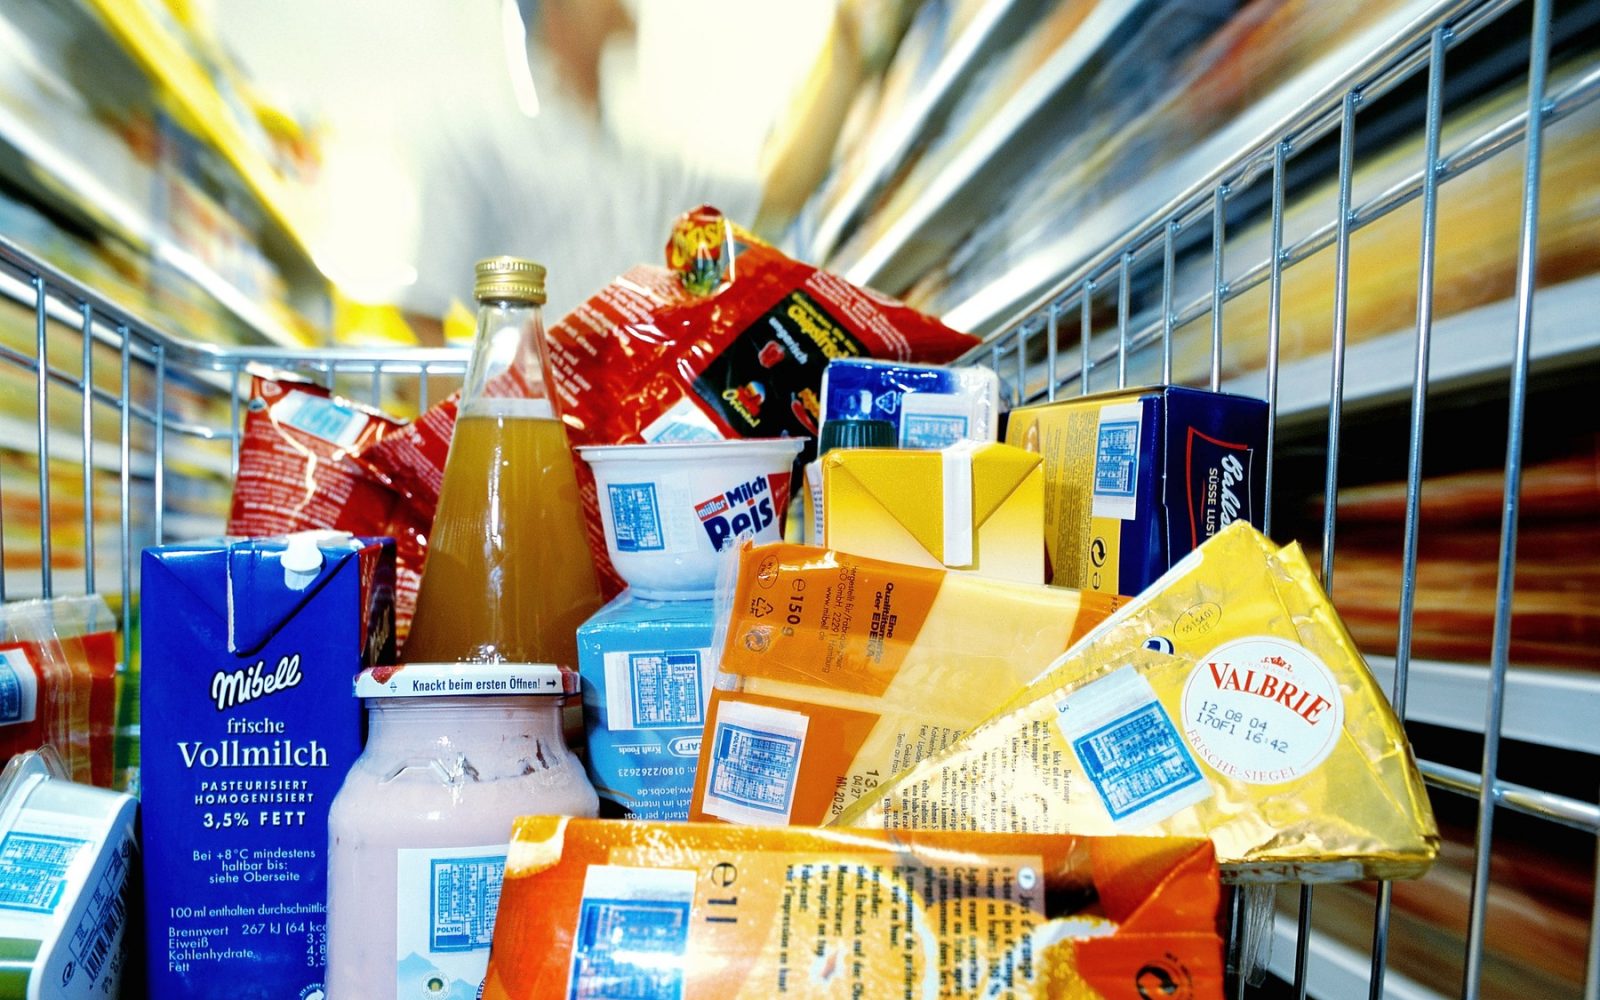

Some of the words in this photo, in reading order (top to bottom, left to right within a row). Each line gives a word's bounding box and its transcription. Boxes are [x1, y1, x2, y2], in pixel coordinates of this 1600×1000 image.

[725, 475, 768, 508] Milch
[1207, 467, 1219, 506] SÜSSE
[697, 498, 727, 519] müller
[703, 497, 773, 553] Reis
[1206, 508, 1216, 537] LUST
[833, 583, 846, 609] GmbH,
[873, 591, 883, 610] der
[787, 594, 804, 625] 150
[867, 612, 882, 657] EDEKA
[886, 614, 898, 639] Eine
[822, 640, 837, 673] Hamburg
[210, 652, 304, 712] Mibell
[412, 679, 446, 692] Knackt
[449, 678, 474, 691] beim
[476, 677, 507, 690] ersten
[509, 674, 542, 689] Öffnen!
[1207, 661, 1332, 727] VALBRIE
[1058, 704, 1069, 713] 3
[1200, 700, 1217, 715] 12
[1225, 709, 1243, 723] 08
[1249, 717, 1267, 731] 04
[226, 717, 285, 734] frische
[1195, 711, 1235, 735] 170F1
[1244, 729, 1289, 754] 16:42
[176, 740, 330, 768] Vollmilch
[618, 747, 640, 755] Foods
[640, 746, 662, 754] Kraft
[617, 766, 685, 776] 0180/2262623
[201, 780, 309, 792] PASTEURISIERT
[836, 776, 848, 790] MV
[850, 775, 864, 800] 04/27
[864, 769, 880, 793] 13.
[194, 792, 315, 805] HOMOGENISIERT
[662, 800, 674, 809] im
[202, 812, 250, 830] 3,5%
[259, 810, 307, 827] FETT
[645, 810, 659, 820] per
[193, 849, 212, 861] Bei
[253, 846, 316, 859] mindestens
[221, 859, 263, 872] haltbar
[267, 858, 290, 870] bis:
[209, 872, 240, 884] siehe
[243, 871, 302, 883] Oberseite
[170, 906, 193, 919] 100
[194, 905, 207, 918] ml
[208, 903, 255, 917] enthalten
[168, 926, 230, 938] Brennwert
[242, 923, 267, 936] 267
[286, 921, 306, 936] (64
[436, 926, 462, 934] POLYIC
[168, 936, 210, 950] Eiweiß
[168, 947, 255, 963] Kohlenhydrate
[168, 961, 191, 973] Fett
